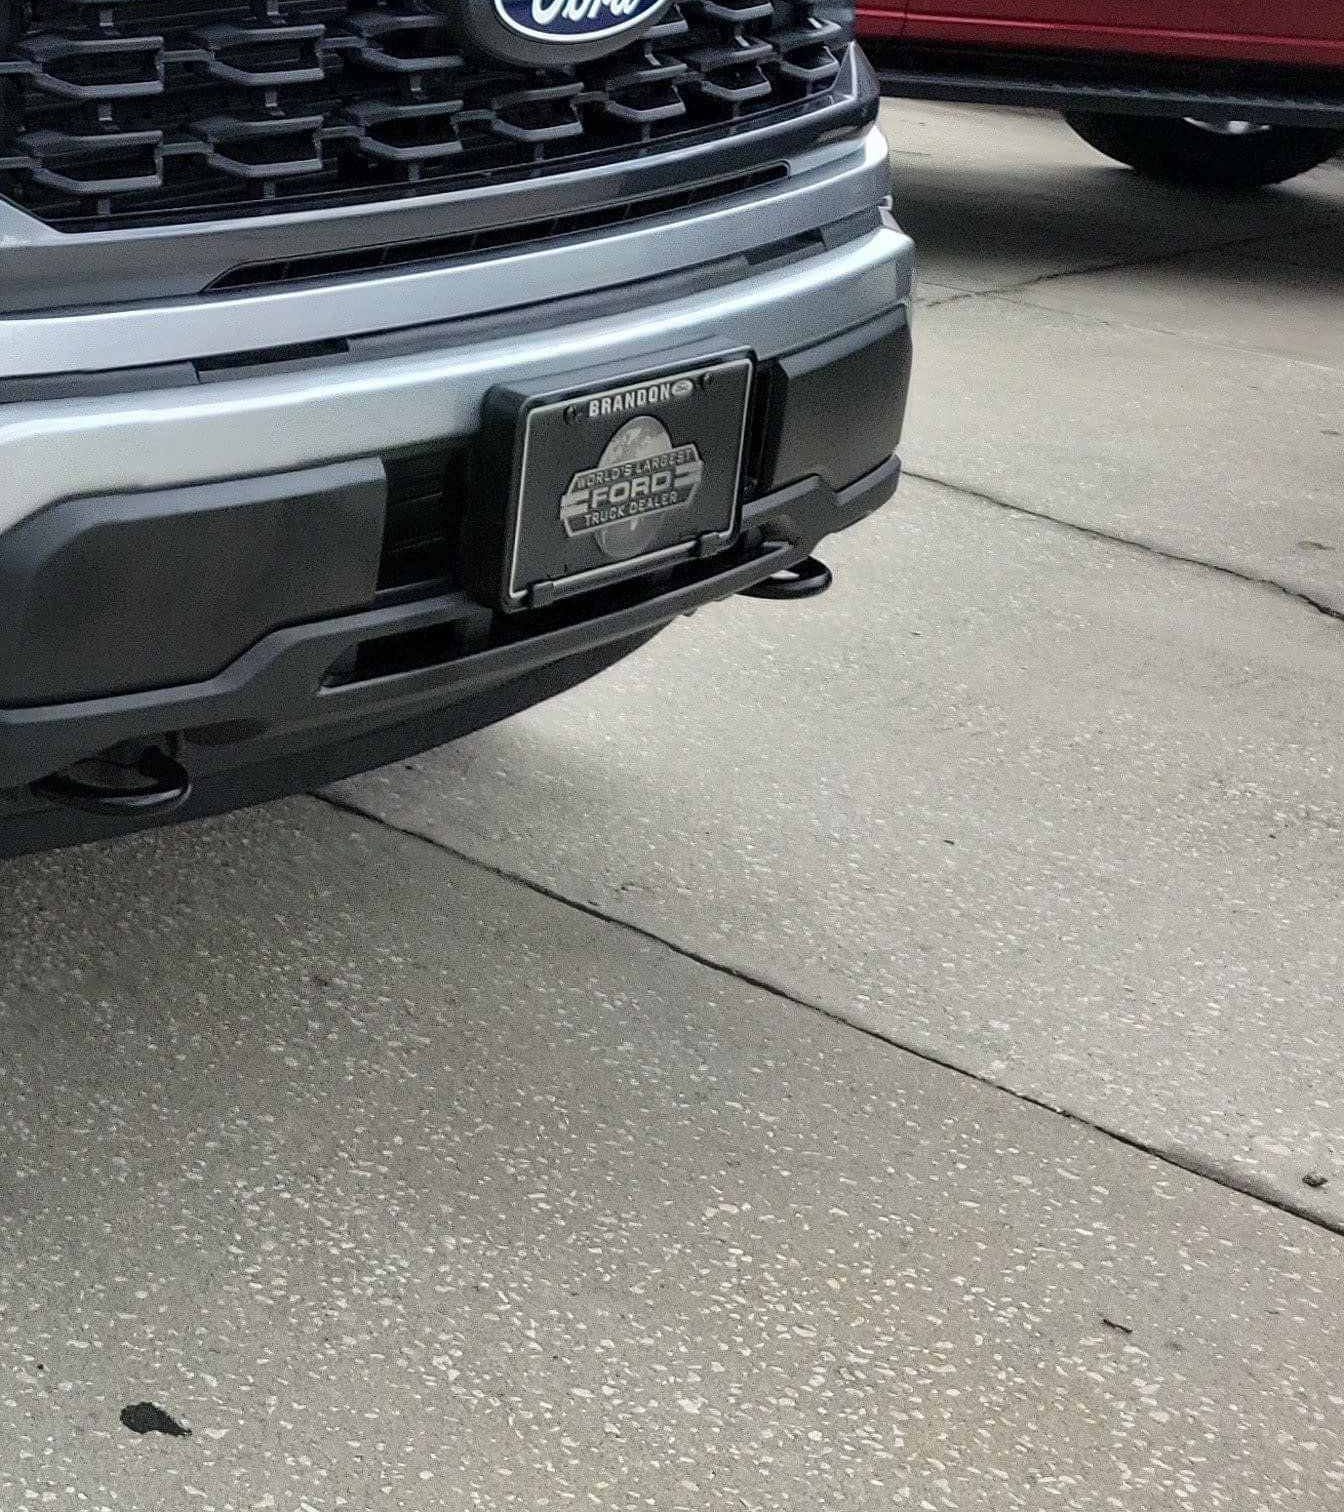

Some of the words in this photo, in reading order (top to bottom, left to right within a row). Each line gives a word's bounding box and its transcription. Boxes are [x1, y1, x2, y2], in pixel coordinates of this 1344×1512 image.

[588, 383, 671, 418] BRANDON
[576, 462, 633, 489] WORLD'S
[635, 448, 694, 474] LARGEST
[591, 470, 672, 509] FORD
[584, 506, 625, 527] TRUCK
[628, 491, 679, 515] DEALER
